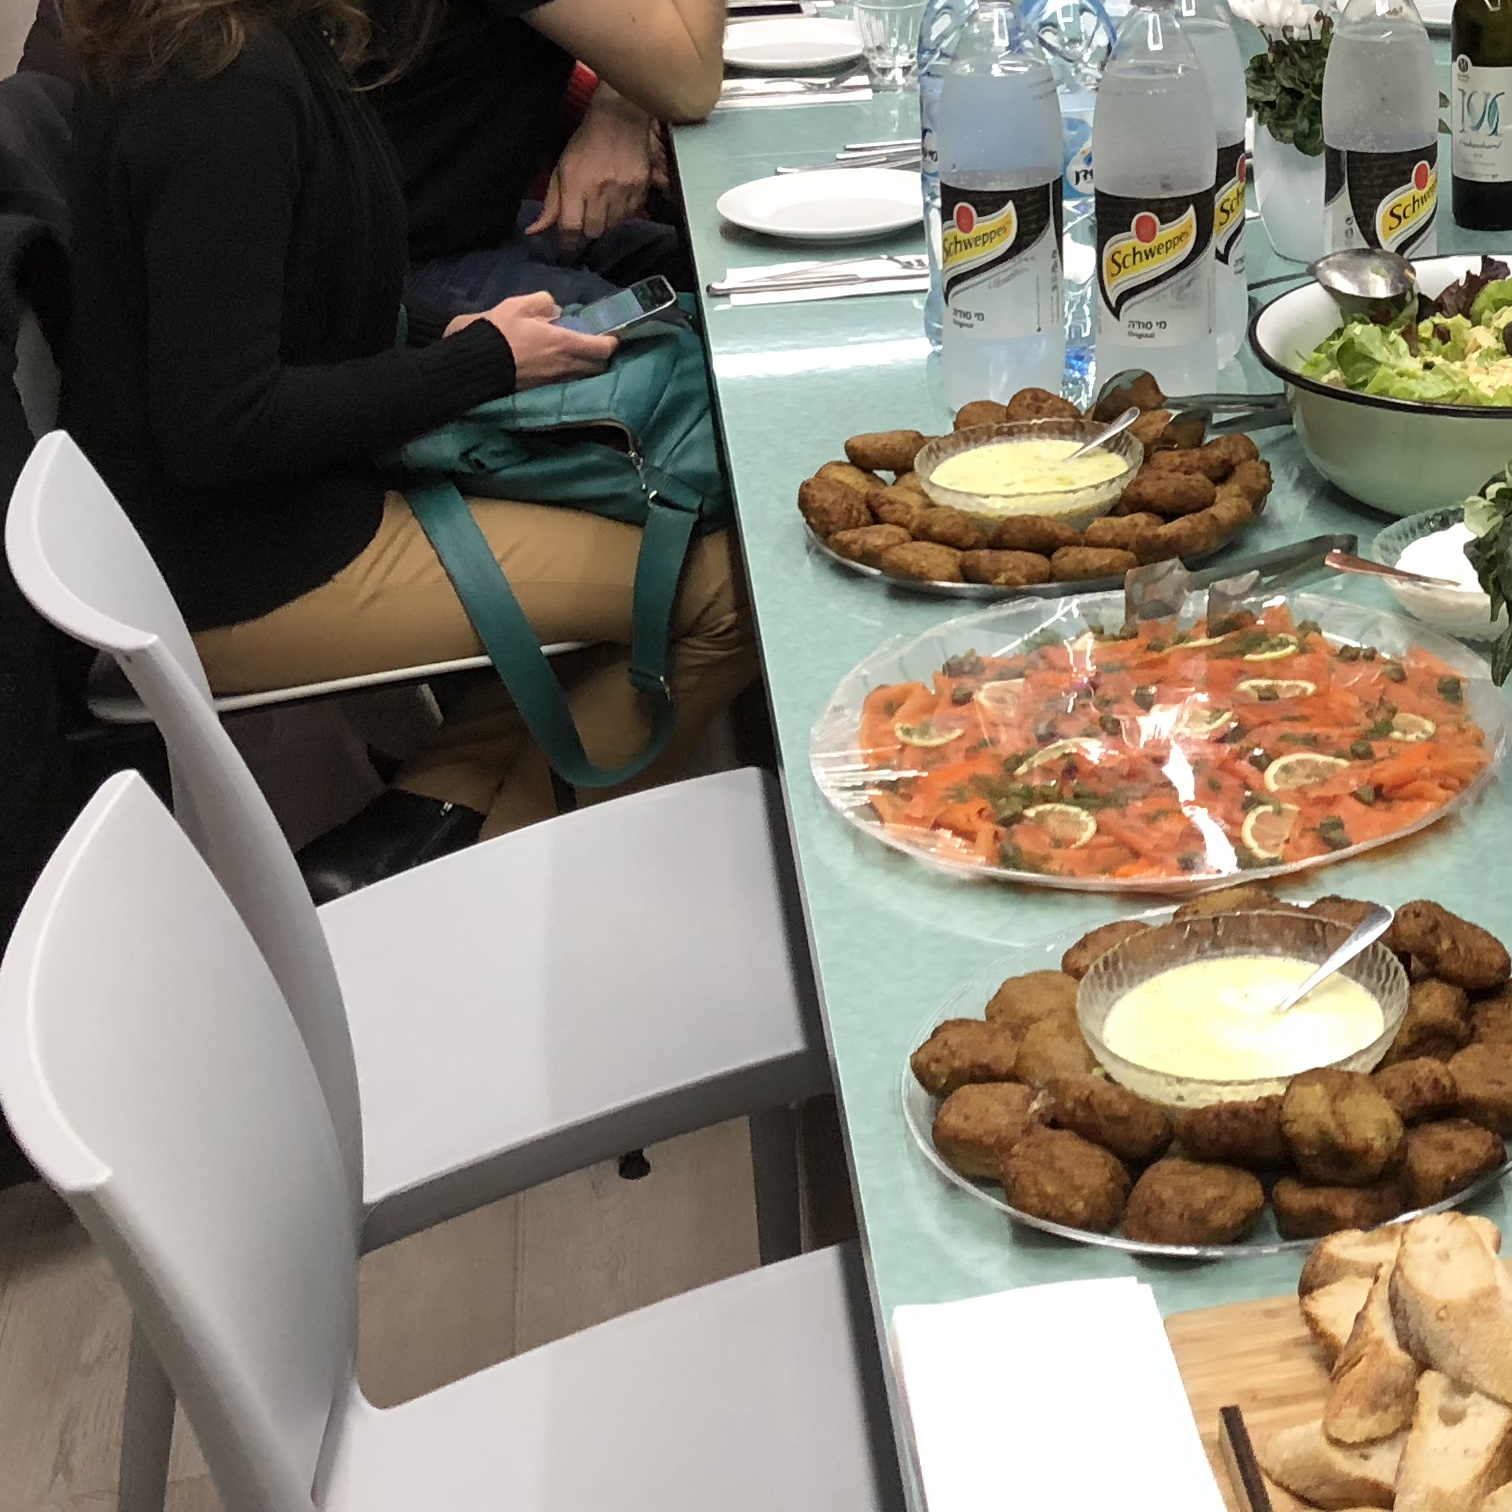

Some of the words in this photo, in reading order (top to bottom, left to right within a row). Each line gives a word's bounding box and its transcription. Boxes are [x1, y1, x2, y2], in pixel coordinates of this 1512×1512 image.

[1111, 230, 1190, 278] Schweppes
[1127, 320, 1153, 330] סודה
[1155, 322, 1167, 330] מי
